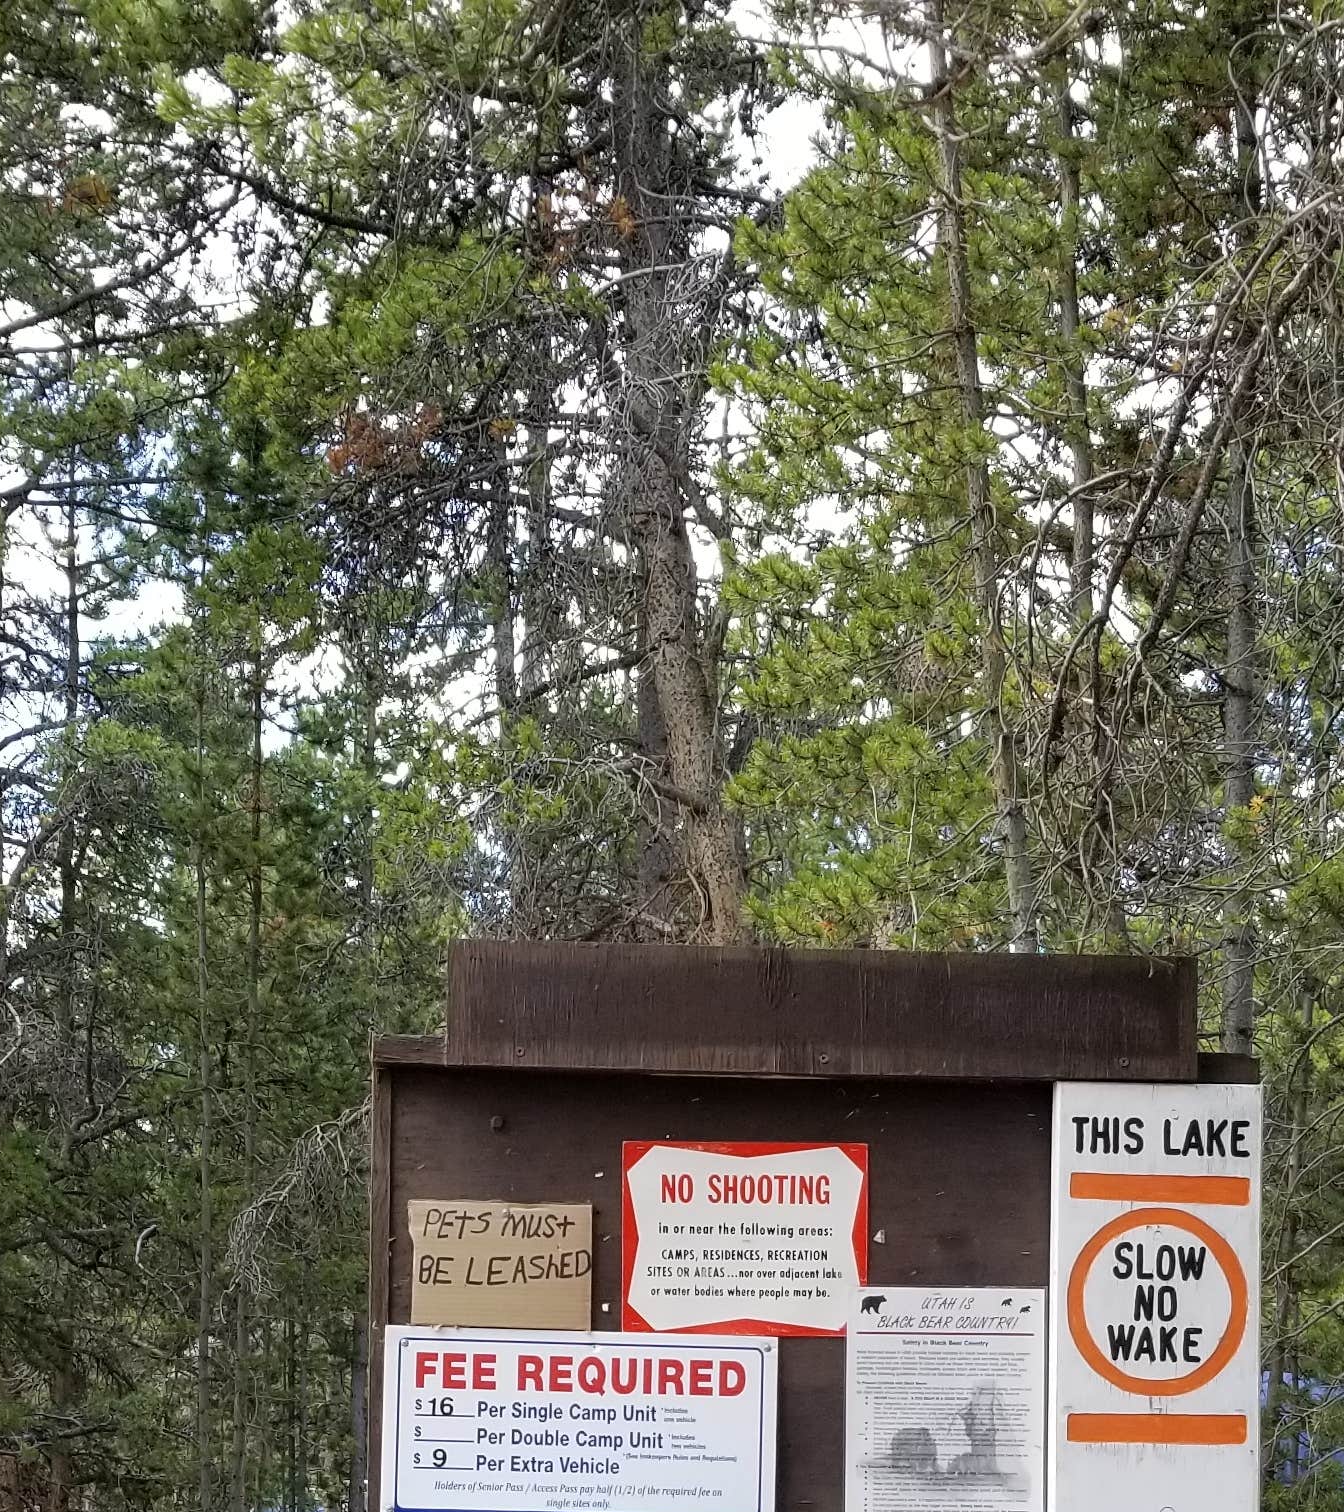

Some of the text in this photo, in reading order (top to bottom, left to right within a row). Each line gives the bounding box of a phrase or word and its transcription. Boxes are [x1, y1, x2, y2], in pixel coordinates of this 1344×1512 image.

[1072, 1116, 1250, 1159] THIS LAKE
[661, 1173, 830, 1205] NO SHOOTING
[658, 1223, 833, 1239] in or near the following areas:
[661, 1248, 828, 1263] CAMPS, RESIDENCES, RECREATION
[1113, 1241, 1206, 1282] SLOW
[418, 1254, 454, 1285] BE
[646, 1266, 673, 1278] SITES
[676, 1267, 690, 1278] OR
[755, 1268, 776, 1280] over
[779, 1267, 819, 1282] adjacent
[650, 1285, 830, 1301] or water bodies where people may be.
[921, 1297, 974, 1310] UTAH IS
[1133, 1284, 1177, 1323] NO
[877, 1315, 913, 1329] BLACK
[918, 1316, 953, 1329] BEAR
[1107, 1325, 1203, 1364] WAKE
[415, 1351, 747, 1397] FEE REQUIRED
[415, 1398, 423, 1411] $
[428, 1396, 454, 1416] 16
[477, 1401, 506, 1419] Per
[511, 1402, 563, 1423] Single
[568, 1403, 617, 1424] Camp
[622, 1405, 657, 1423] Unit
[414, 1425, 422, 1438] $
[476, 1427, 505, 1446] Per
[510, 1428, 569, 1448] Double
[575, 1429, 624, 1451] Camp
[629, 1431, 663, 1449] Unit
[413, 1452, 421, 1465] $
[432, 1448, 447, 1467] 9
[476, 1454, 505, 1473] Per
[510, 1455, 553, 1473] Extra
[559, 1456, 620, 1474] Vehicle
